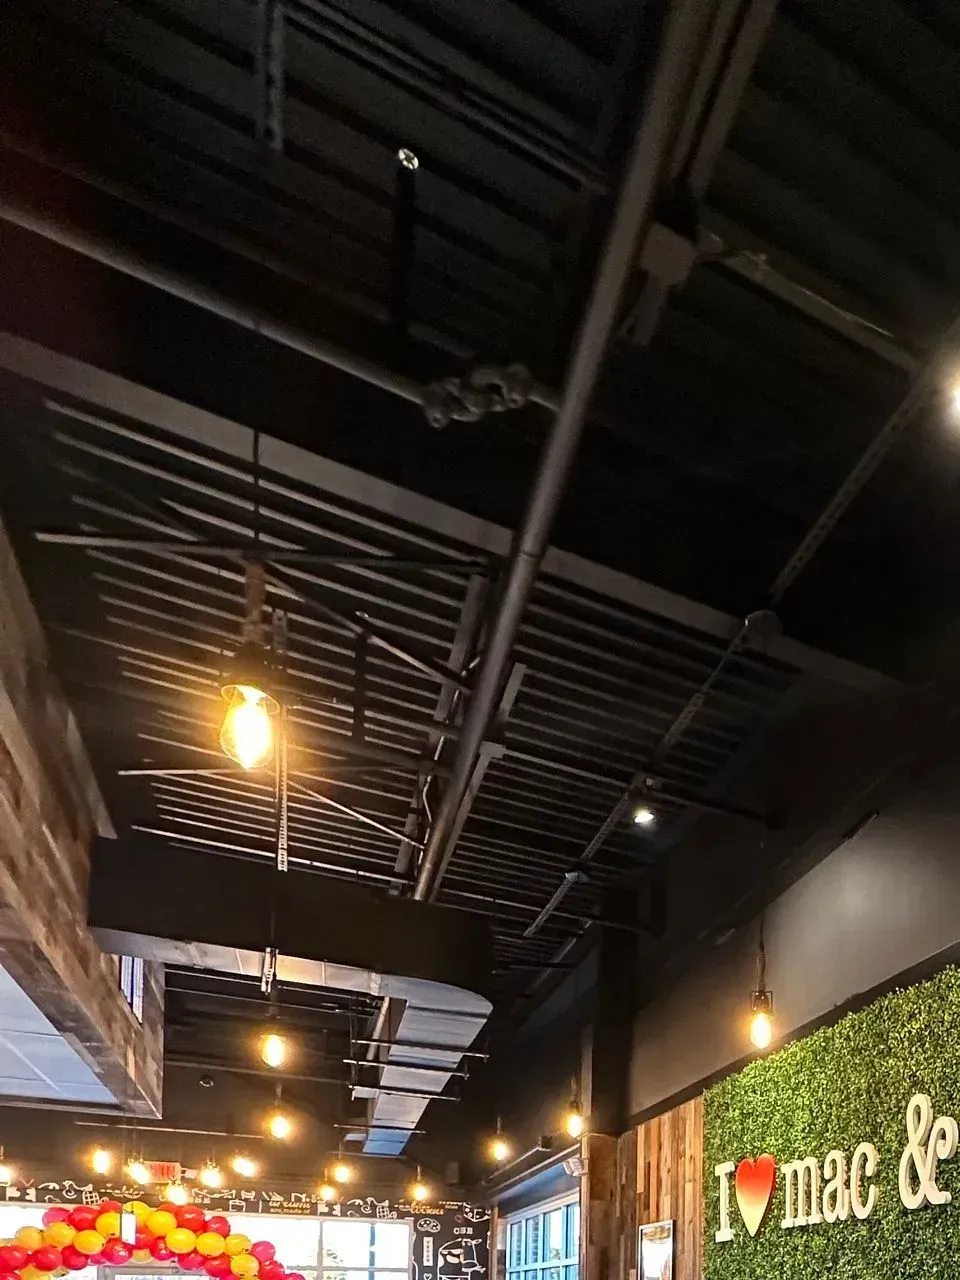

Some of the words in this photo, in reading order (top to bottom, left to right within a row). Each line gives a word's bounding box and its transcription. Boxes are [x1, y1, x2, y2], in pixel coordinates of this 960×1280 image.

[715, 1161, 735, 1243] I
[781, 1142, 878, 1229] mac
[899, 1093, 959, 1210] &
